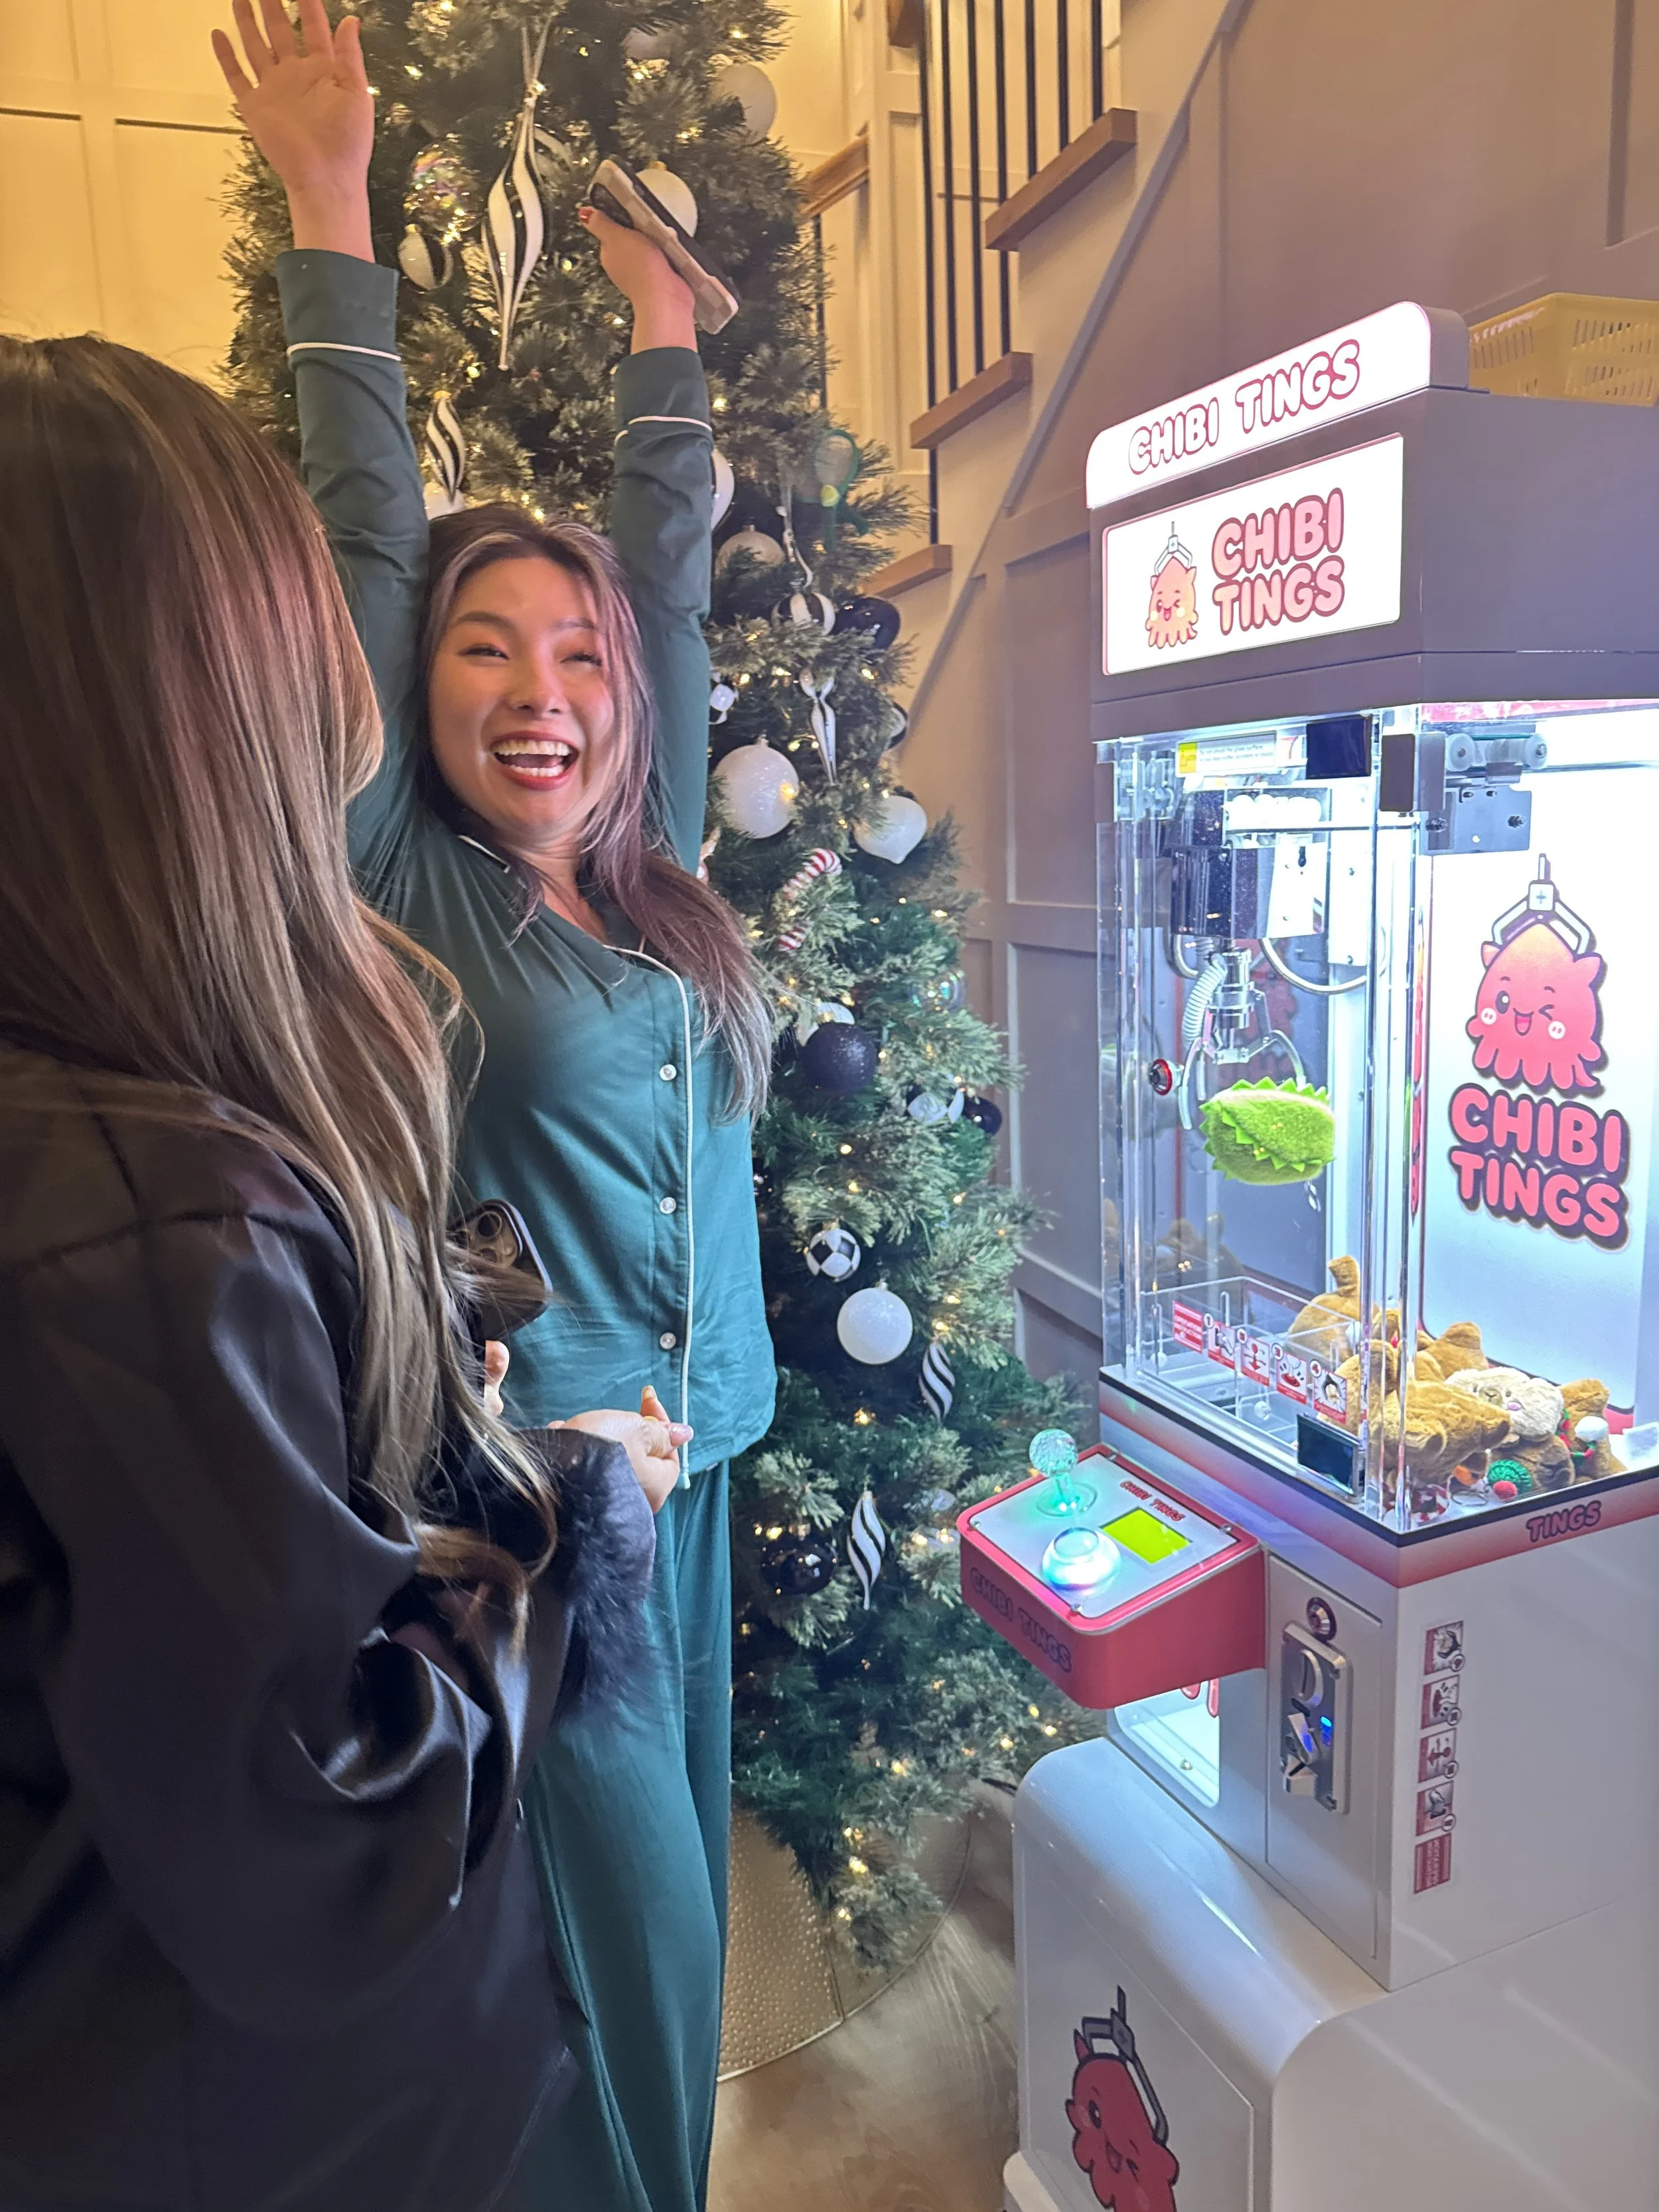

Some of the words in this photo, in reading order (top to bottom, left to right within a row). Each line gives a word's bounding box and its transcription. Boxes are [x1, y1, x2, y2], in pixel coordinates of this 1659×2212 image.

[1129, 397, 1219, 475] CHIBI
[1235, 339, 1360, 433] TINGS
[1212, 487, 1344, 580] CHIBI
[1212, 555, 1344, 636] TINGS
[1449, 1083, 1628, 1175] CHIBI
[1449, 1147, 1628, 1246] TINGS
[1526, 1501, 1601, 1542] TINGS
[970, 1567, 1014, 1622] CHIBI
[1019, 1607, 1072, 1673] TINGS
